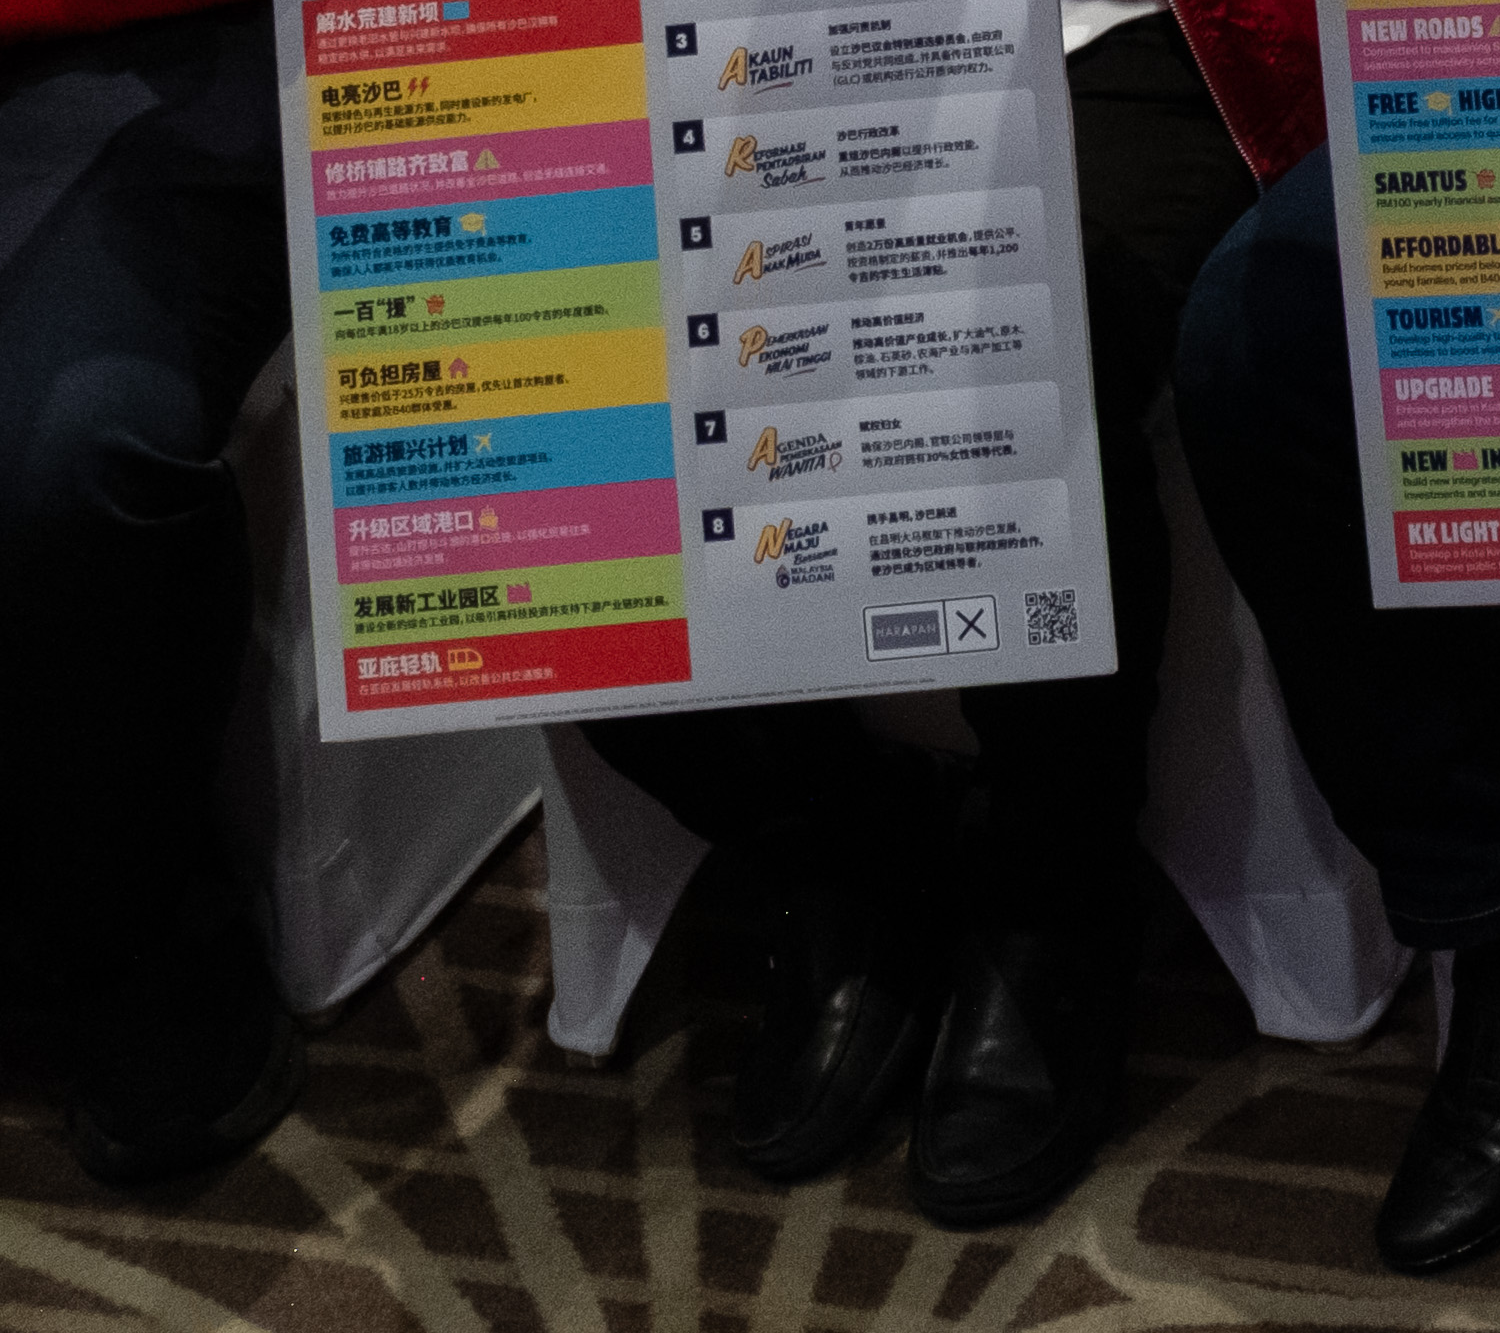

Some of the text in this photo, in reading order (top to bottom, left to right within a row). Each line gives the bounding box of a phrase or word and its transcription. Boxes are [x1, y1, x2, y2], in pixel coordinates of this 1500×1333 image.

[321, 81, 403, 106] 电亮沙巴
[1375, 170, 1467, 194] SARATUS
[338, 360, 442, 389] 可负担房屋
[348, 511, 474, 542] 升级区域港口
[354, 585, 500, 619] 发展新工业园区
